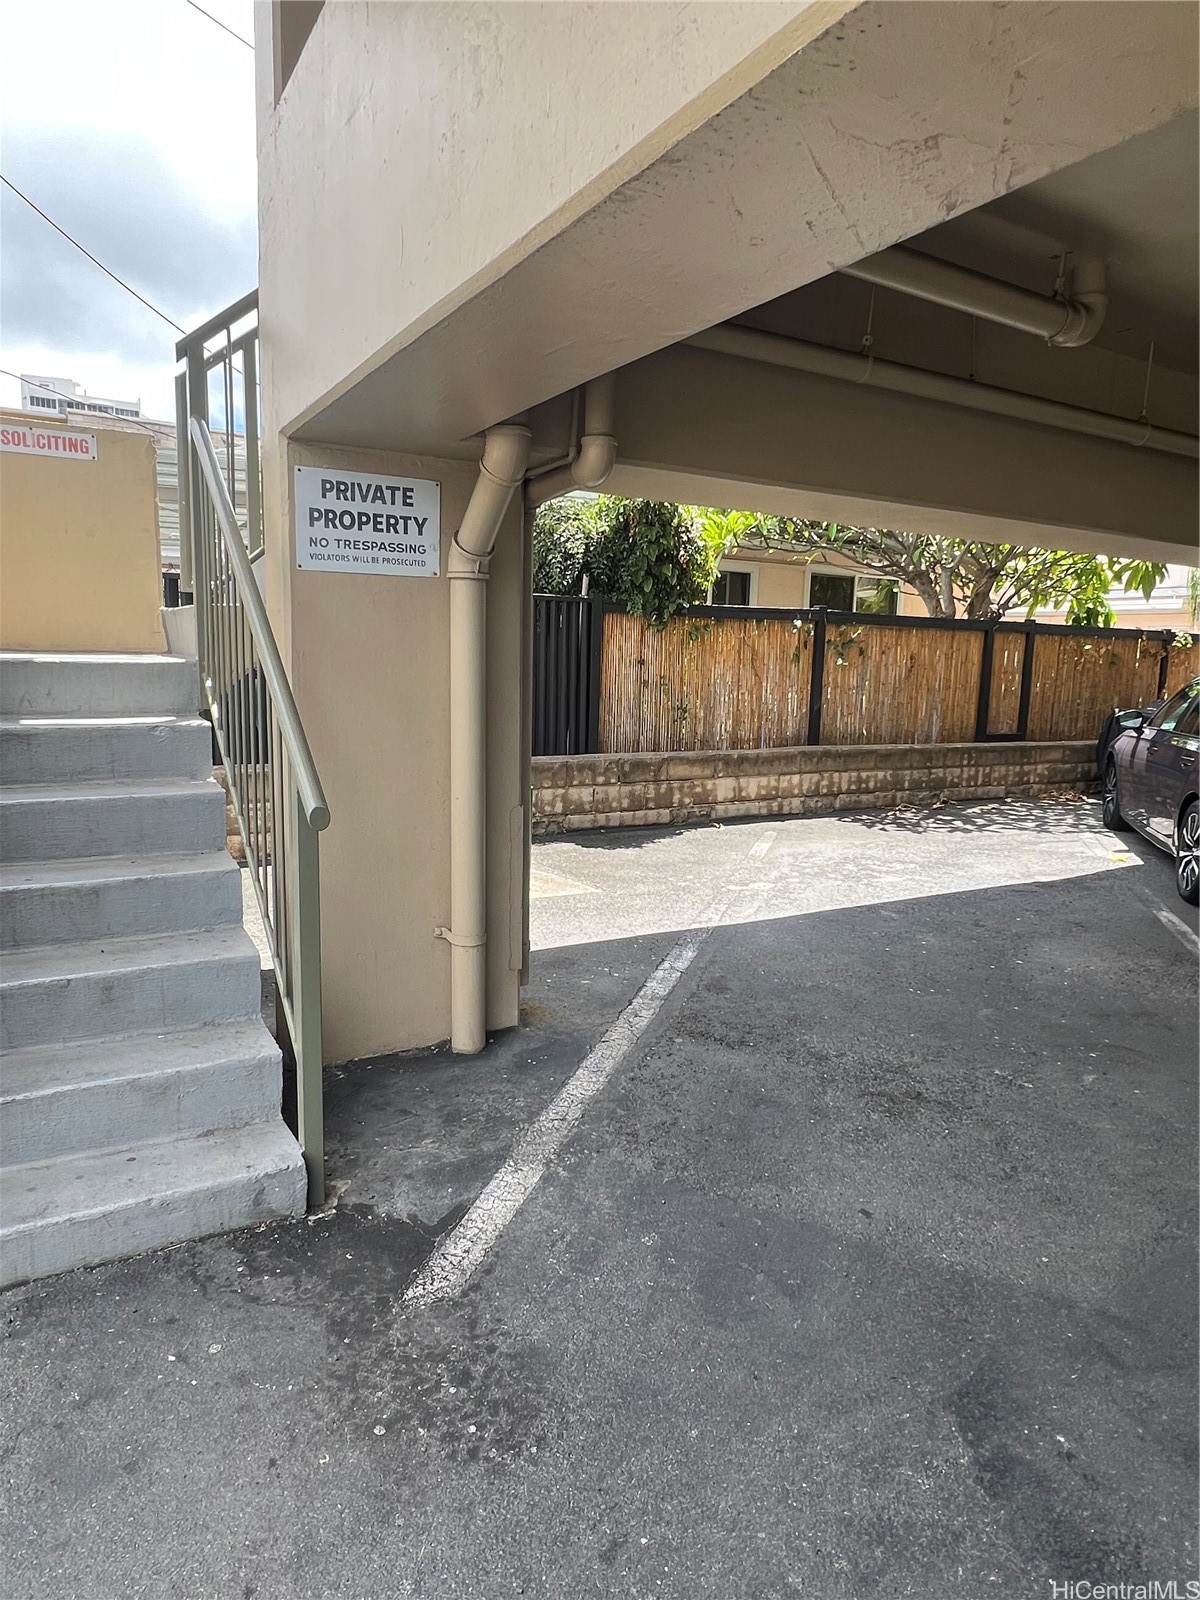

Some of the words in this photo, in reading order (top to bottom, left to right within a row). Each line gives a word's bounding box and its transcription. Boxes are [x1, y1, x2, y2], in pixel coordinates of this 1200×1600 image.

[0, 429, 89, 455] SOLICITING
[321, 478, 415, 508] PRIVATE
[308, 506, 429, 536] PROPERTY
[309, 537, 329, 548] NO
[334, 538, 427, 555] TRESPASSING
[309, 552, 350, 562] VIOLATORS
[352, 555, 370, 564] WILL
[371, 556, 380, 564] BE
[382, 557, 426, 567] PROSECUTED
